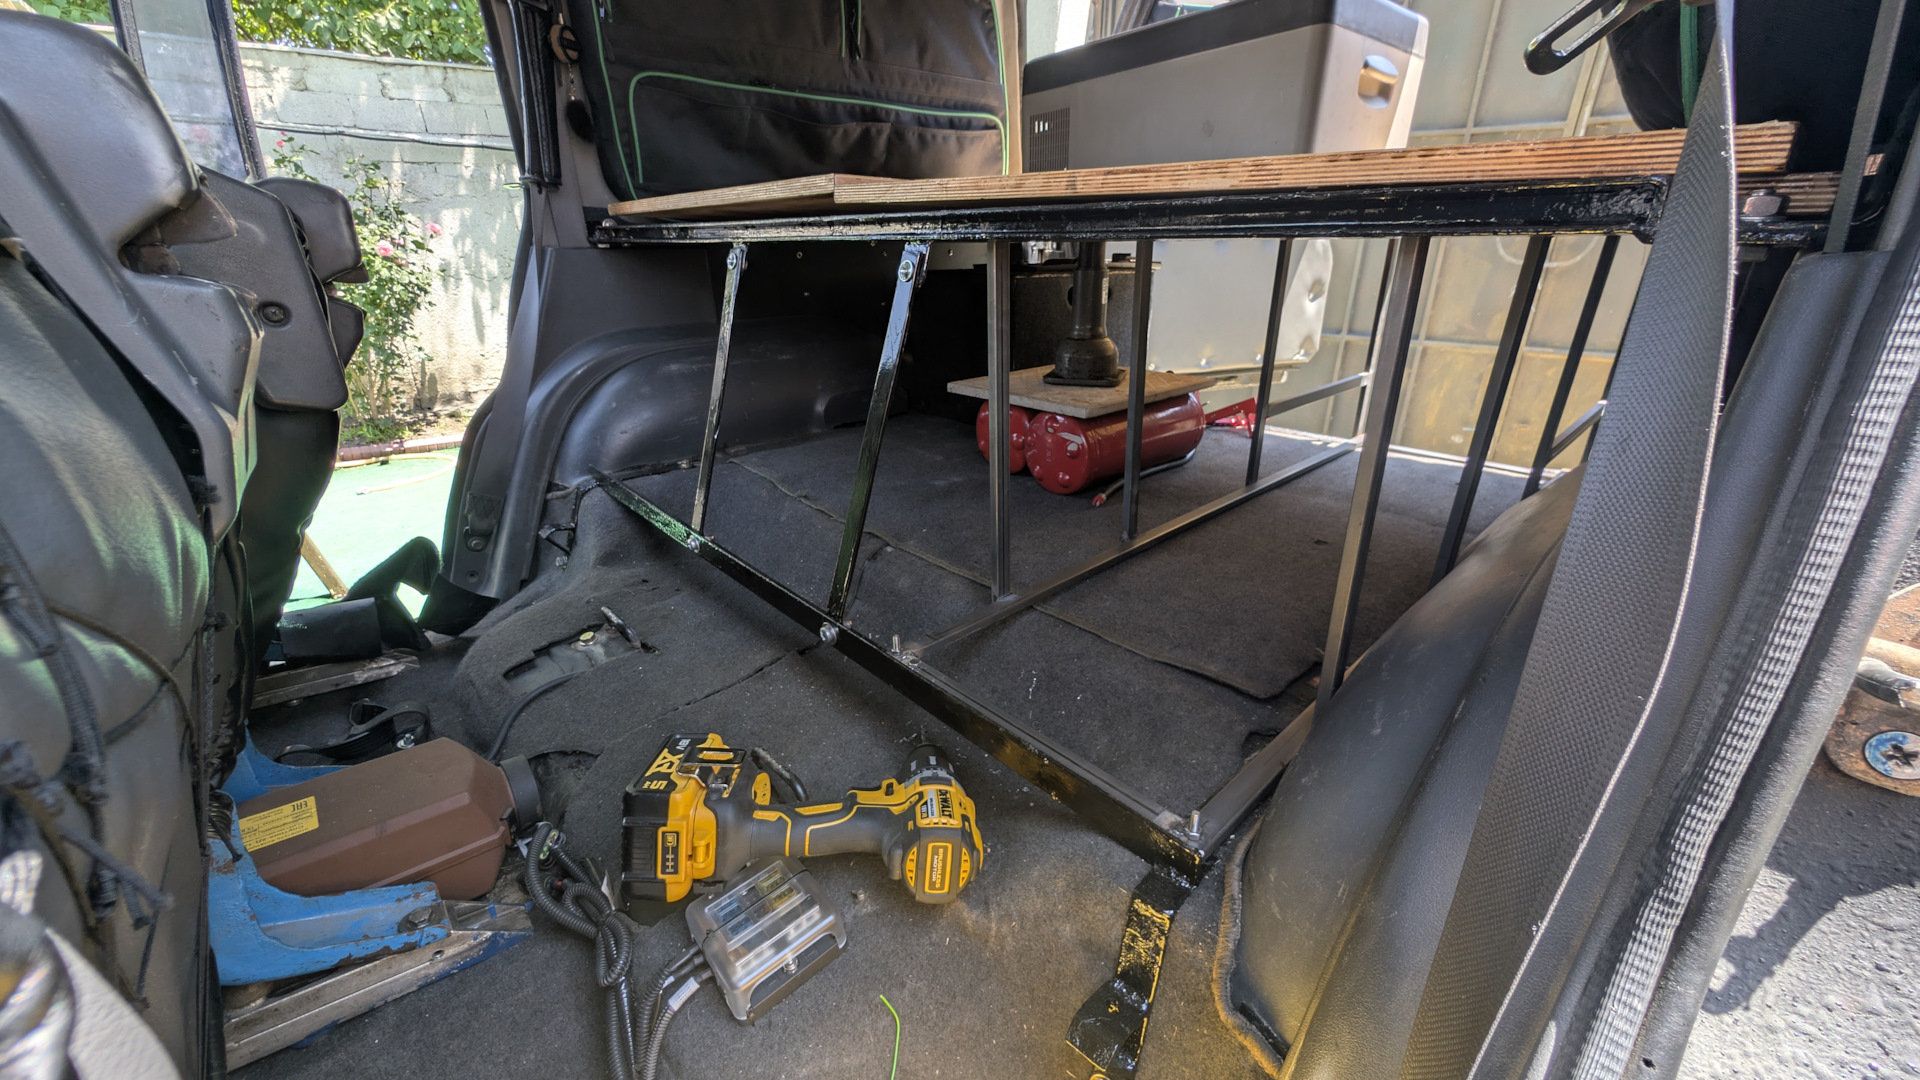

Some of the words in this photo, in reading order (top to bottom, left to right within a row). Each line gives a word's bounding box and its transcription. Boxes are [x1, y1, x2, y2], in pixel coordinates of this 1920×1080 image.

[676, 739, 691, 750] 18V
[644, 748, 684, 777] XR
[935, 848, 944, 888] BRUSHLESS
